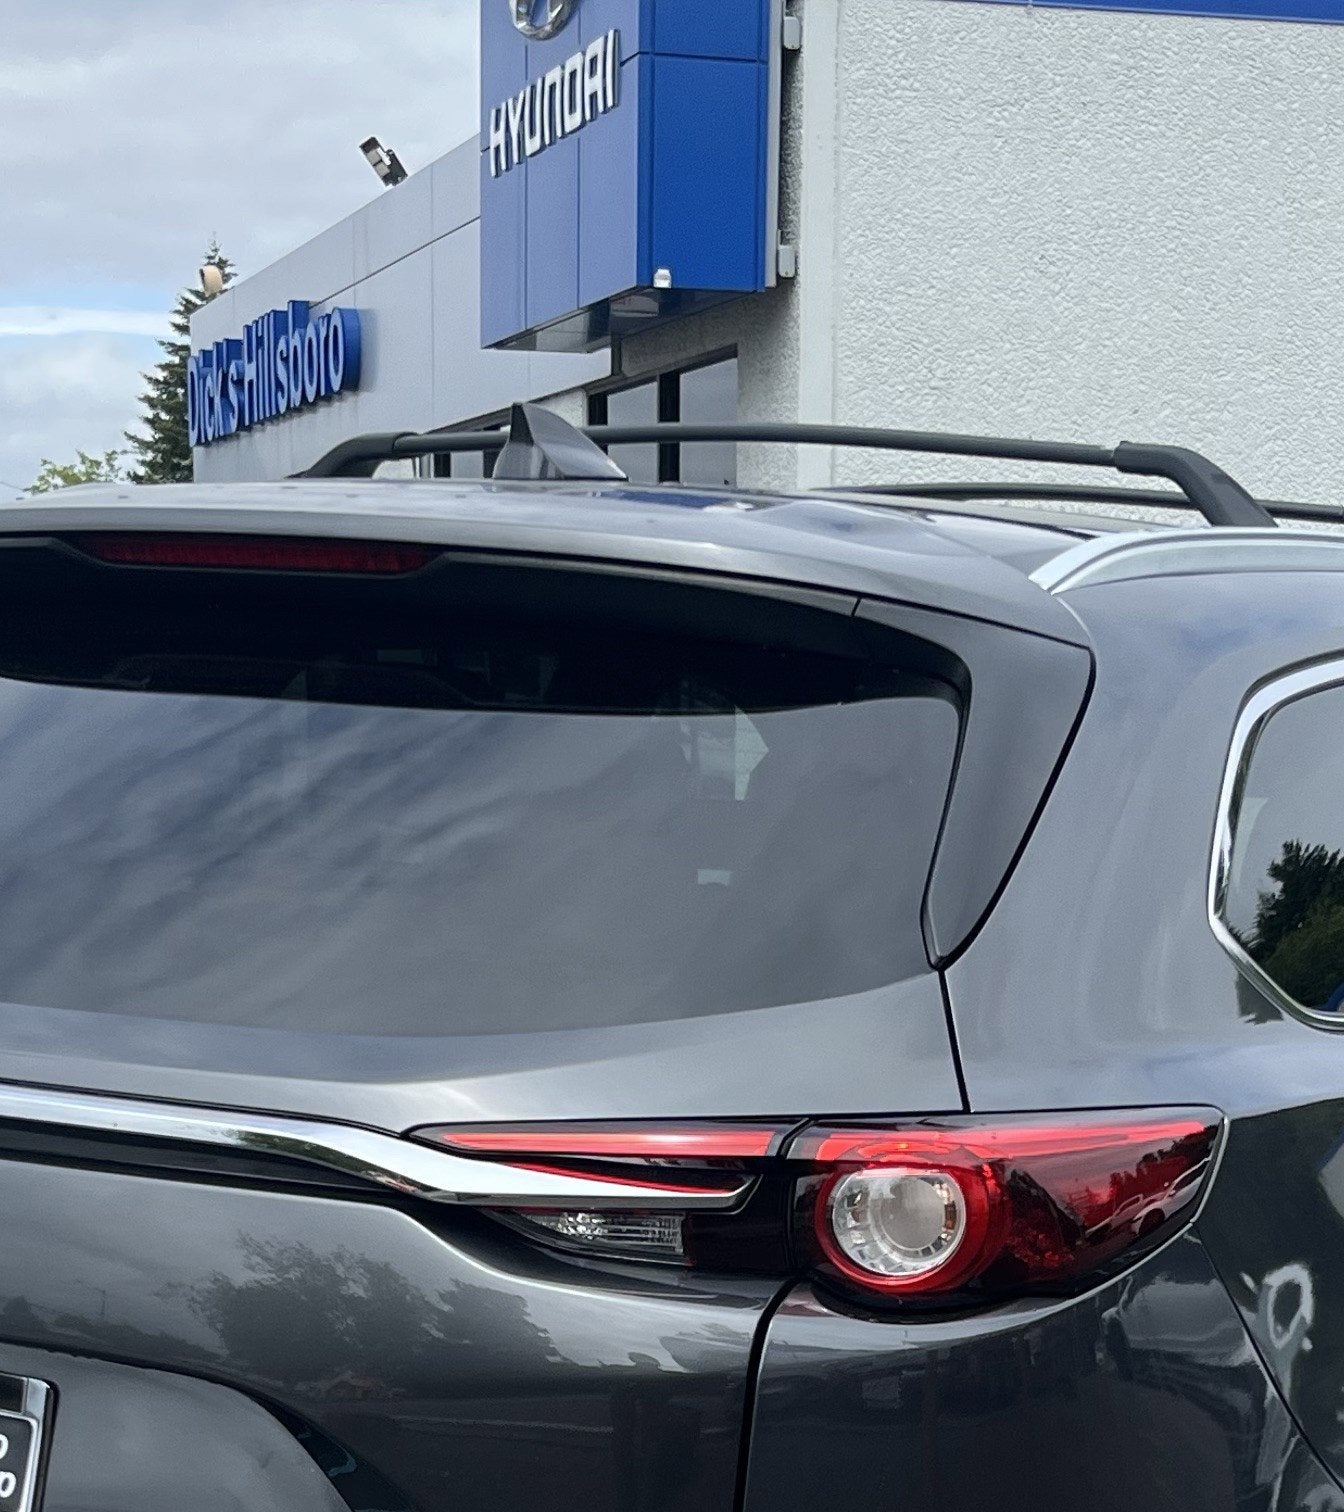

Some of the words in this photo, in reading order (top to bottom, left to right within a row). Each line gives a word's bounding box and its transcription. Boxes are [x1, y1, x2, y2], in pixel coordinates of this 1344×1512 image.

[490, 29, 618, 178] HYUNDAI
[188, 339, 242, 447] Dick's
[243, 300, 354, 426] Hillsboro
